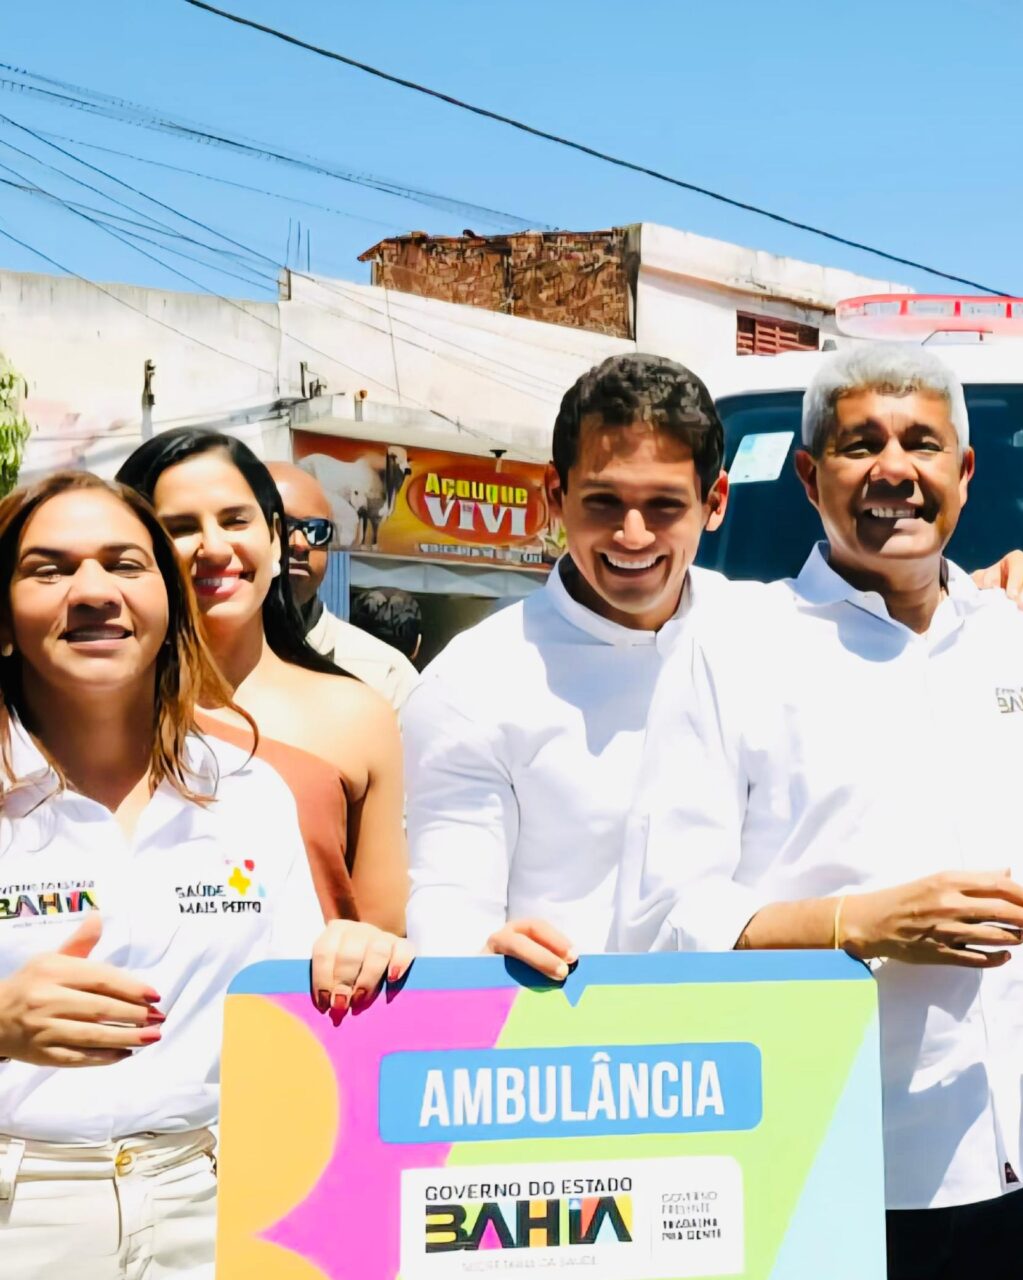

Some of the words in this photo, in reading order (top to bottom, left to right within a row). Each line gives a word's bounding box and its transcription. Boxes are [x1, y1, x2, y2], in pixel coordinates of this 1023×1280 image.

[424, 495, 527, 537] VIVI
[418, 1051, 726, 1128] AMBULÂNCIA
[425, 1182, 521, 1201] GOVERNO
[528, 1180, 555, 1197] DO
[561, 1176, 633, 1195] ESTADO
[425, 1196, 633, 1253] BAHIA
